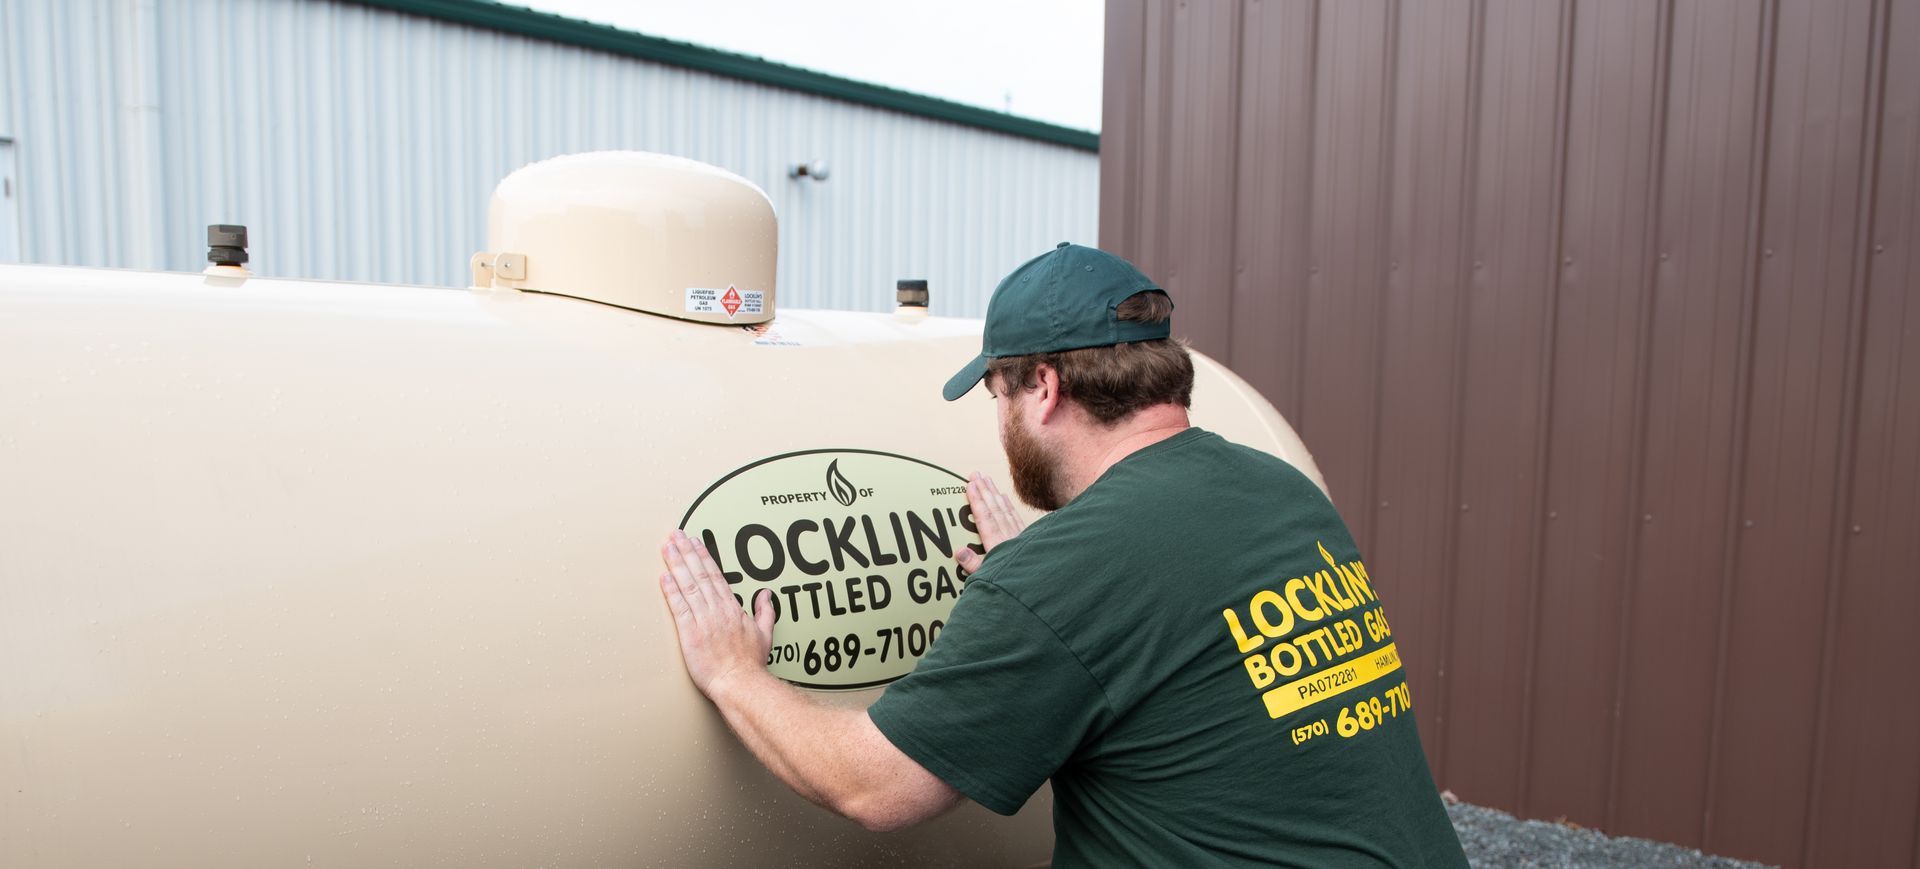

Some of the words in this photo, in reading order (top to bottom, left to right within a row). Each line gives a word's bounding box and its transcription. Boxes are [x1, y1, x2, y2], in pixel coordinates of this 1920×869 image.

[761, 491, 827, 506] PROPERTY
[859, 487, 874, 499] OF
[930, 486, 967, 496] PA07228
[734, 575, 892, 624] OTTLED
[1223, 561, 1380, 654] LOCKLIN'
[1244, 618, 1363, 690] BOTTLED
[1297, 667, 1358, 700] PA072281
[1291, 718, 1329, 745] (570)
[1336, 682, 1411, 738] 689-710
